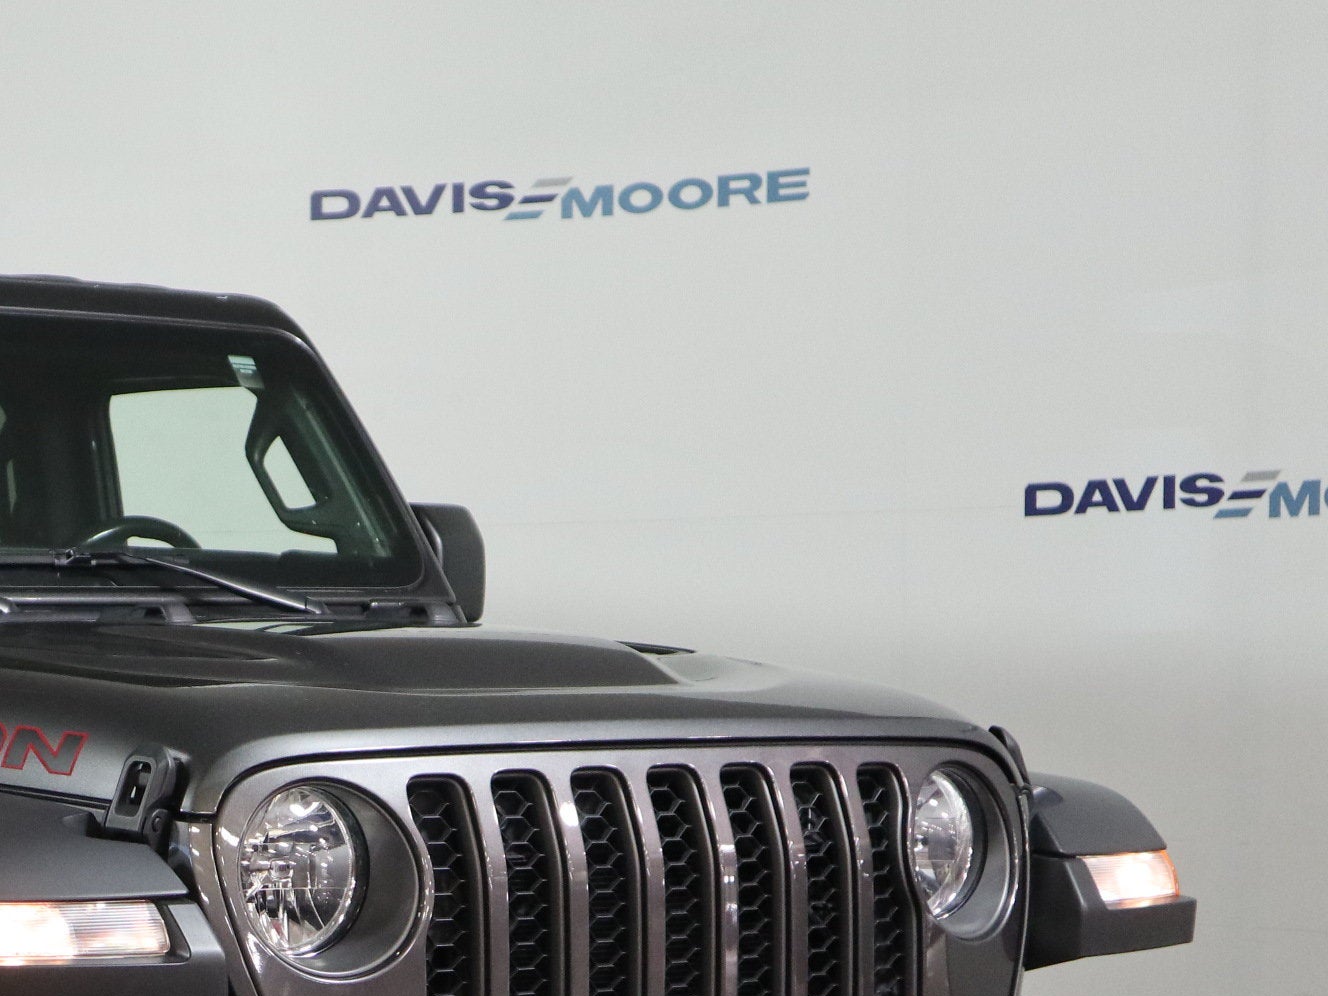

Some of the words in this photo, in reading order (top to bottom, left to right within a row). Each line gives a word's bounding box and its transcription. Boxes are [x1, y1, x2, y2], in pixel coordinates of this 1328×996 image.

[309, 179, 517, 222] DAVIS
[560, 166, 812, 220] MOORE
[1023, 471, 1227, 519] DAVIS
[1267, 478, 1328, 520] M
